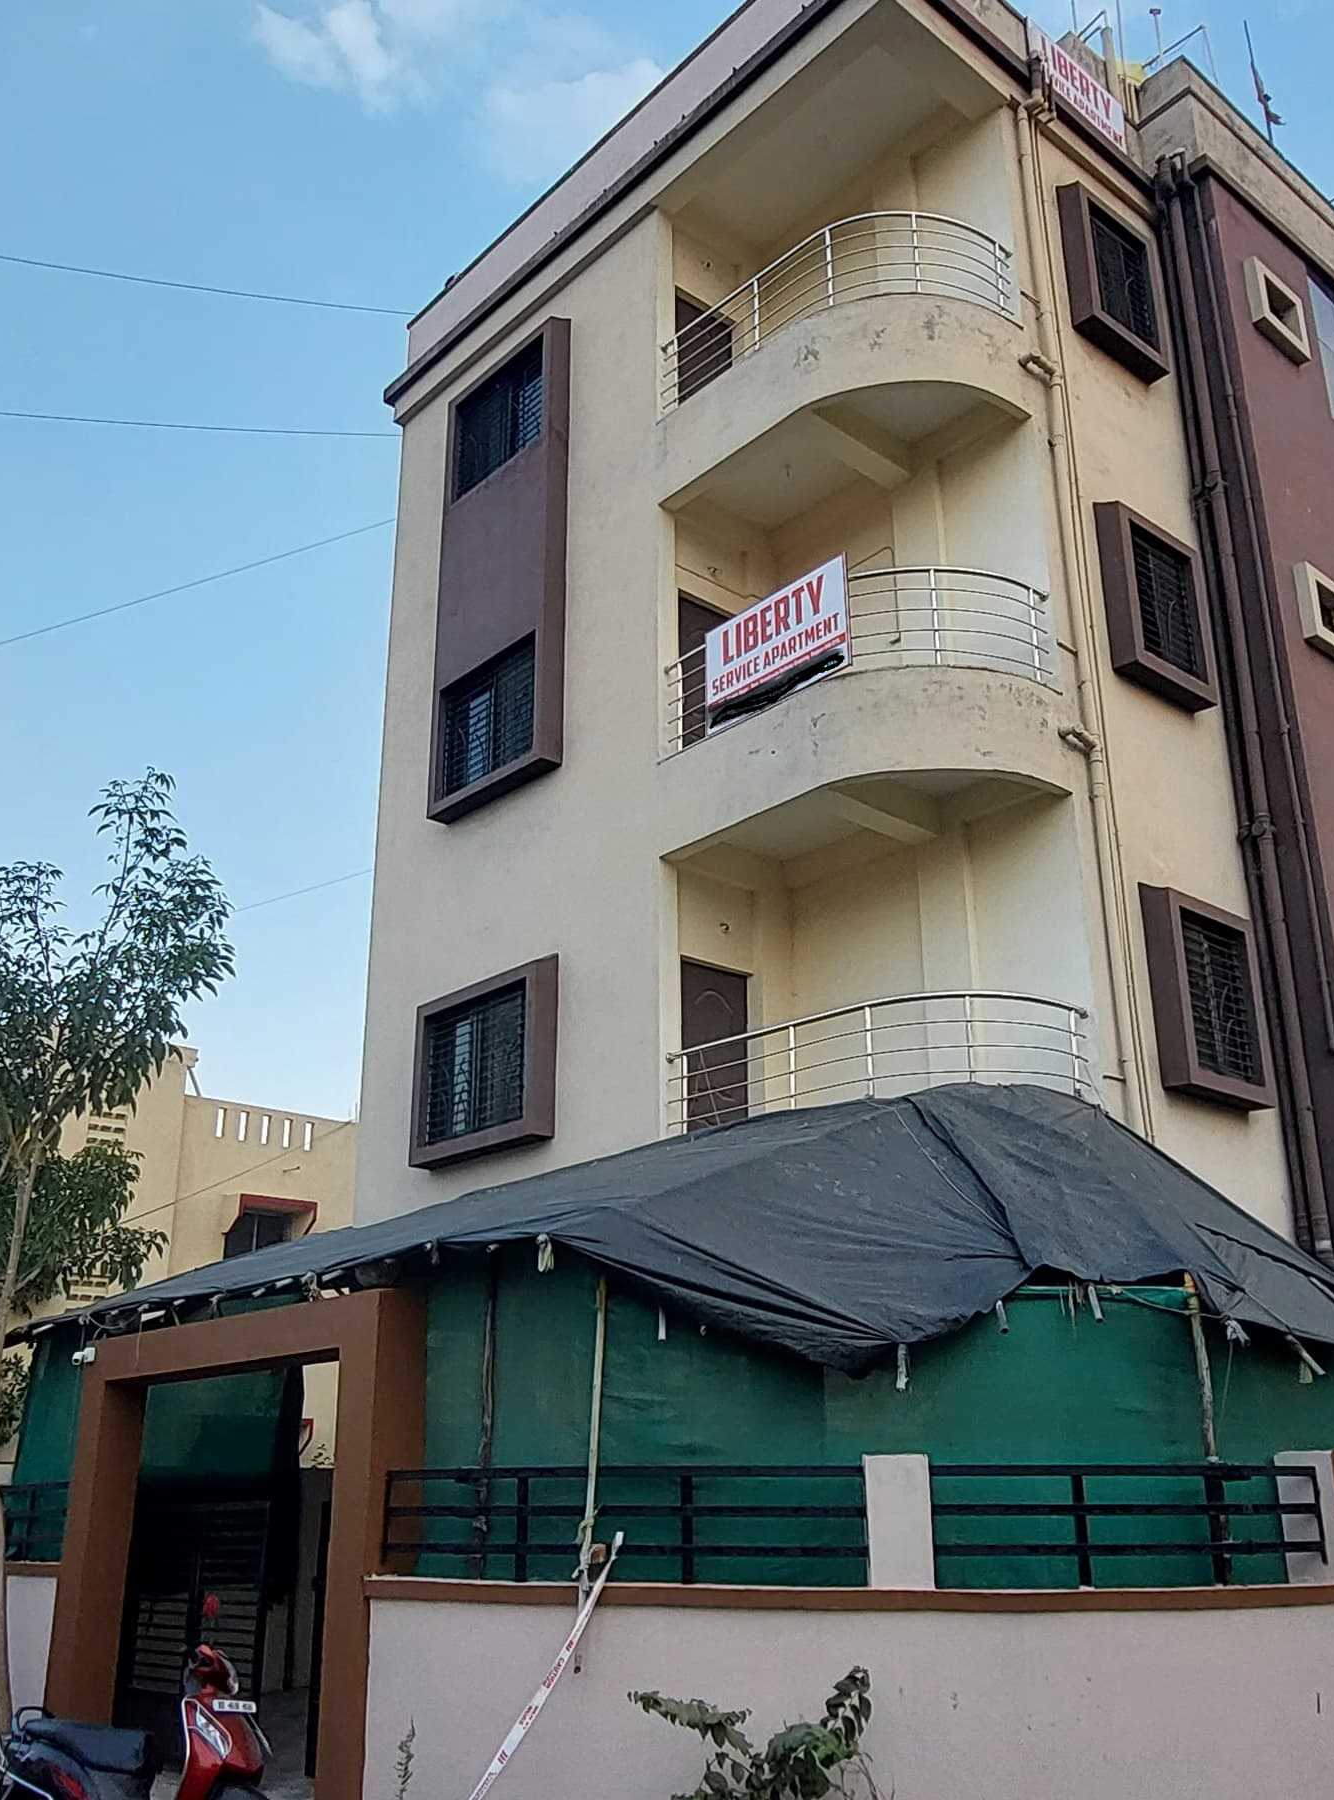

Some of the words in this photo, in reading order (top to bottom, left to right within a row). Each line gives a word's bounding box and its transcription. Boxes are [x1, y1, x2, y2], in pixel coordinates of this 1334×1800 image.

[1073, 94, 1124, 144] APARTMENT
[712, 656, 760, 696] SERVICE
[763, 612, 839, 667] APARTMENT
[722, 574, 824, 666] LIBERTY
